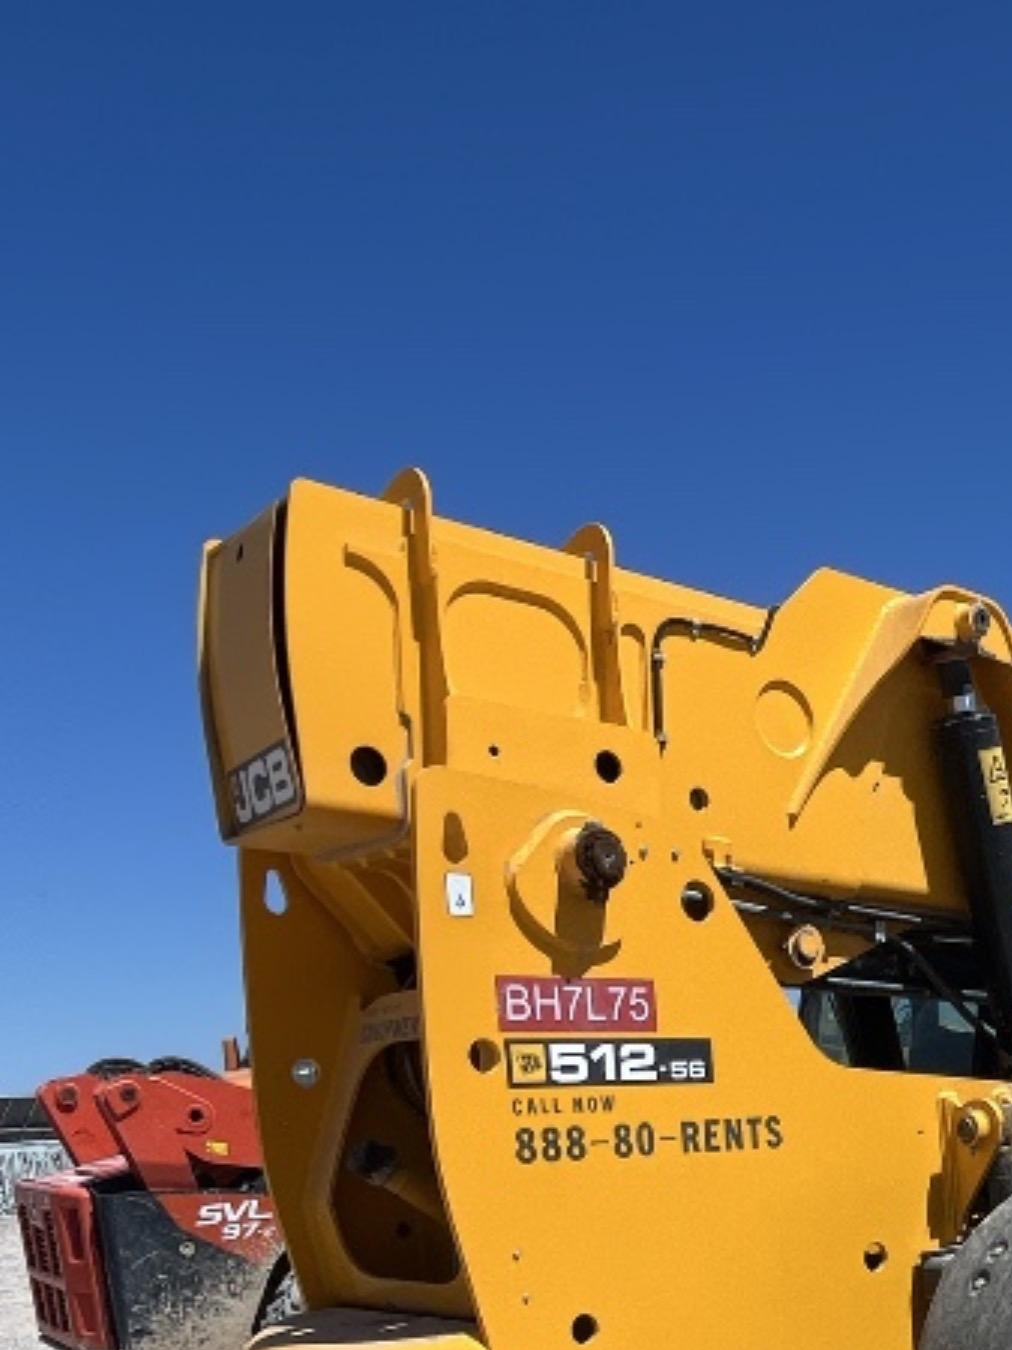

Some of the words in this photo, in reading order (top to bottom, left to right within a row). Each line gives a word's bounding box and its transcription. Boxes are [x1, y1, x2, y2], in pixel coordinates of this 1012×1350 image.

[235, 746, 295, 824] JCB
[504, 982, 650, 1021] BH7L75
[511, 1096, 563, 1116] CALL
[572, 1094, 616, 1113] NOW
[514, 1114, 784, 1165] 888-80-RENTS
[195, 1198, 274, 1228] SVL
